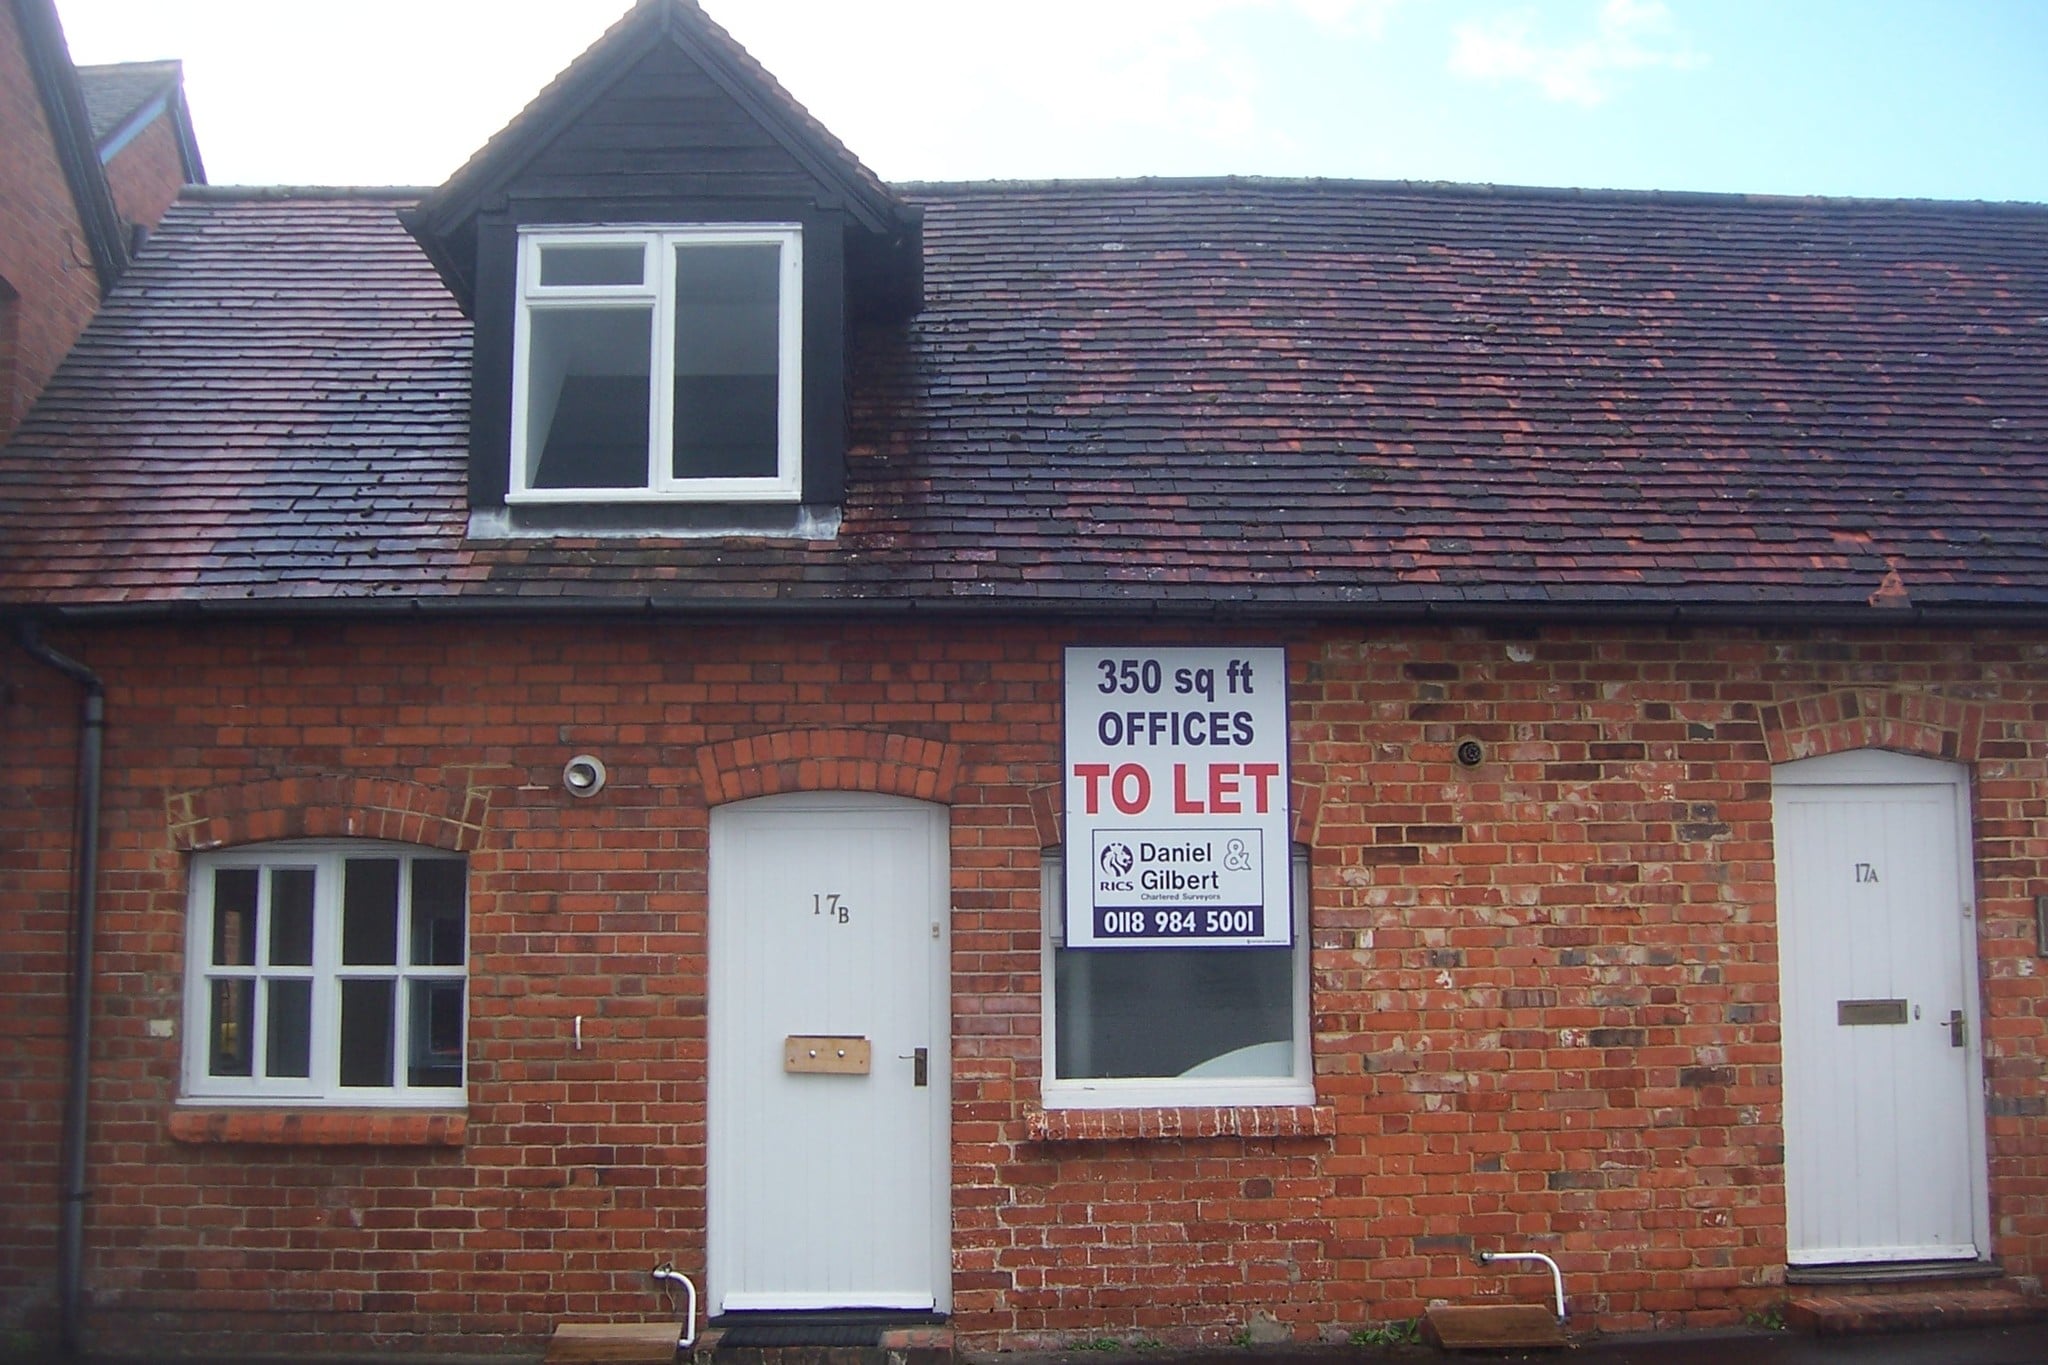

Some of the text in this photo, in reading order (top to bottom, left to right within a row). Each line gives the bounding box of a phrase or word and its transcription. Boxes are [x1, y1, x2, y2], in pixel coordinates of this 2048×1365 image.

[1097, 660, 1254, 702] 350 sq ft
[1098, 711, 1254, 746] OFFICES
[1074, 763, 1279, 815] TO LET
[1140, 838, 1251, 871] Daniel &
[1100, 881, 1134, 891] RICS
[1140, 870, 1219, 890] Gilbert
[1140, 892, 1221, 902] Chartered Surveyors
[1104, 910, 1254, 933] 0118 984 5001
